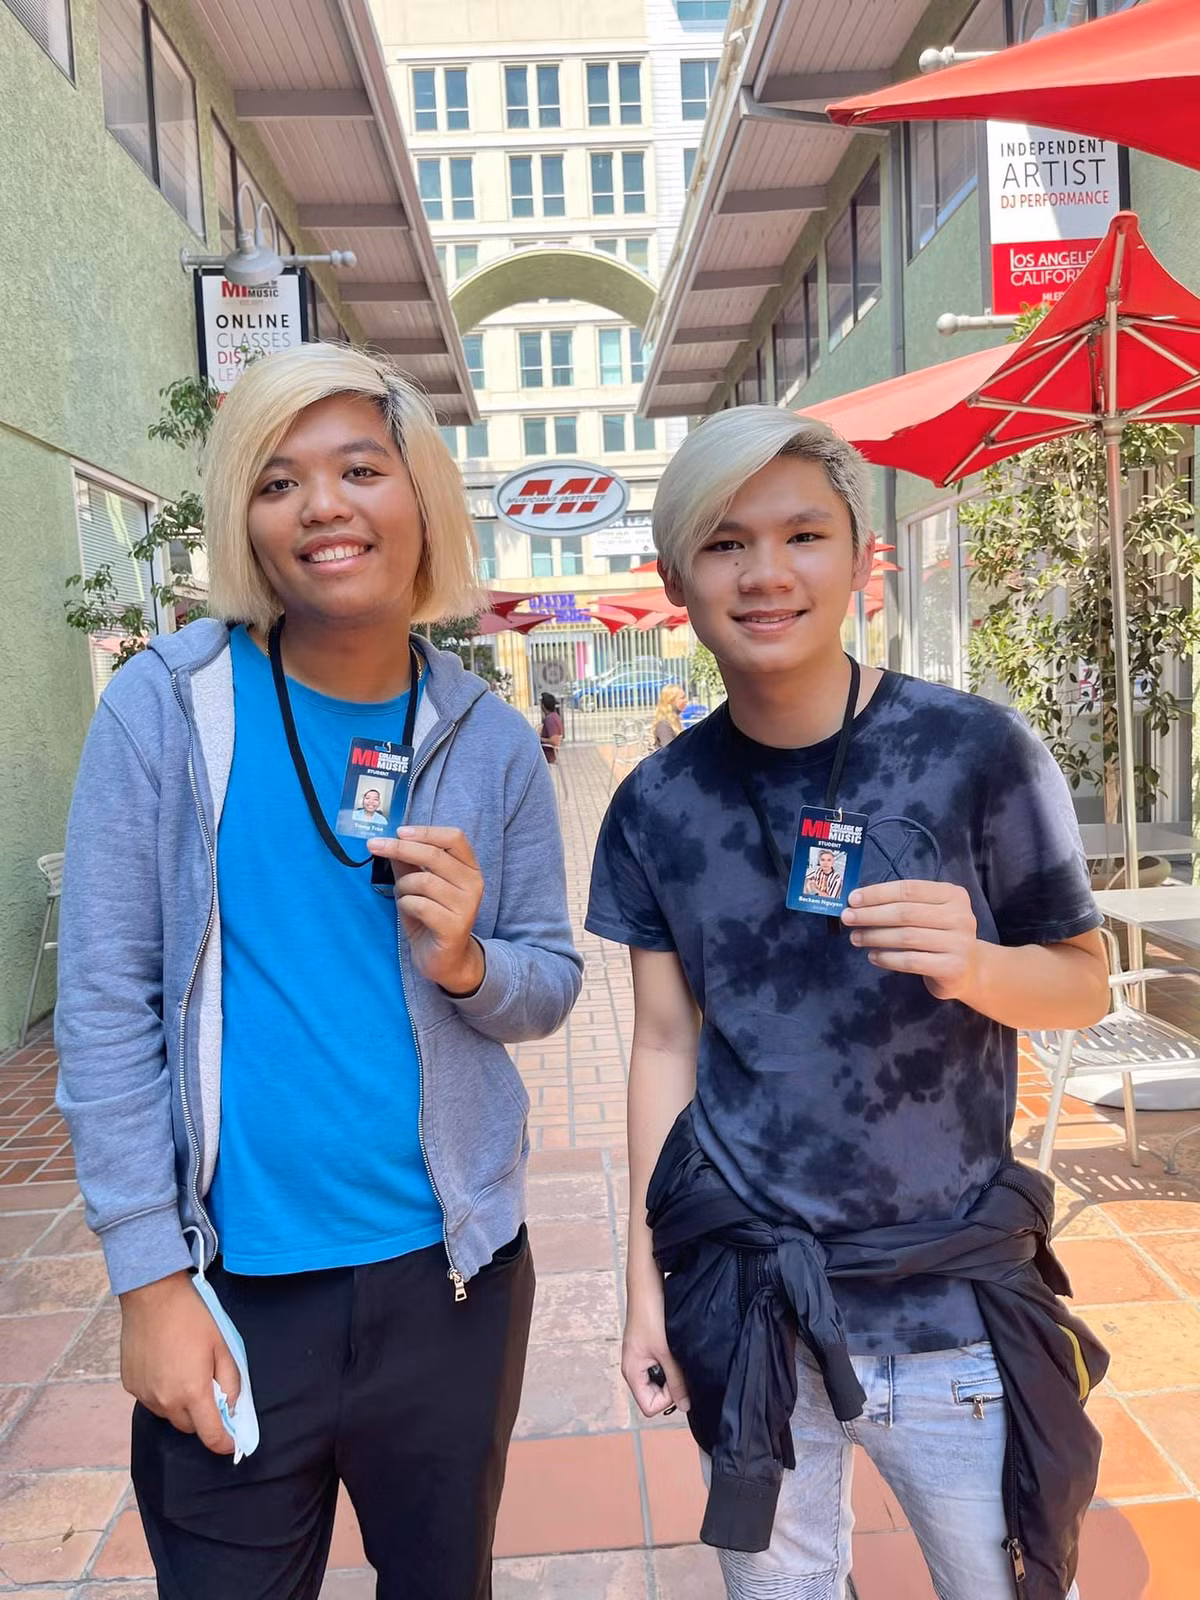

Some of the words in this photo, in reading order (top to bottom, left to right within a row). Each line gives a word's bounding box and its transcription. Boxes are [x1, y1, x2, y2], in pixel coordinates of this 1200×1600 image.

[1000, 139, 1106, 157] INDEPENDENT
[1002, 158, 1106, 189] ARTIST
[1000, 195, 1016, 209] DJ
[1020, 190, 1109, 208] PERFORMANCE
[1037, 250, 1094, 266] ANGELE
[1010, 269, 1082, 286] CALIFOR
[247, 289, 279, 298] MUSIC
[216, 314, 290, 329] ONLINE
[216, 332, 292, 348] CLASSES
[507, 496, 557, 504] MUSICIANS
[559, 494, 607, 503] INSTITUTE
[351, 748, 379, 768] MI
[367, 769, 389, 777] STUDENT
[377, 761, 408, 773] MUSIC
[802, 819, 830, 838] MI
[831, 823, 855, 831] COLLEGE
[818, 841, 842, 849] STUDENT
[828, 832, 862, 844] MUSIC
